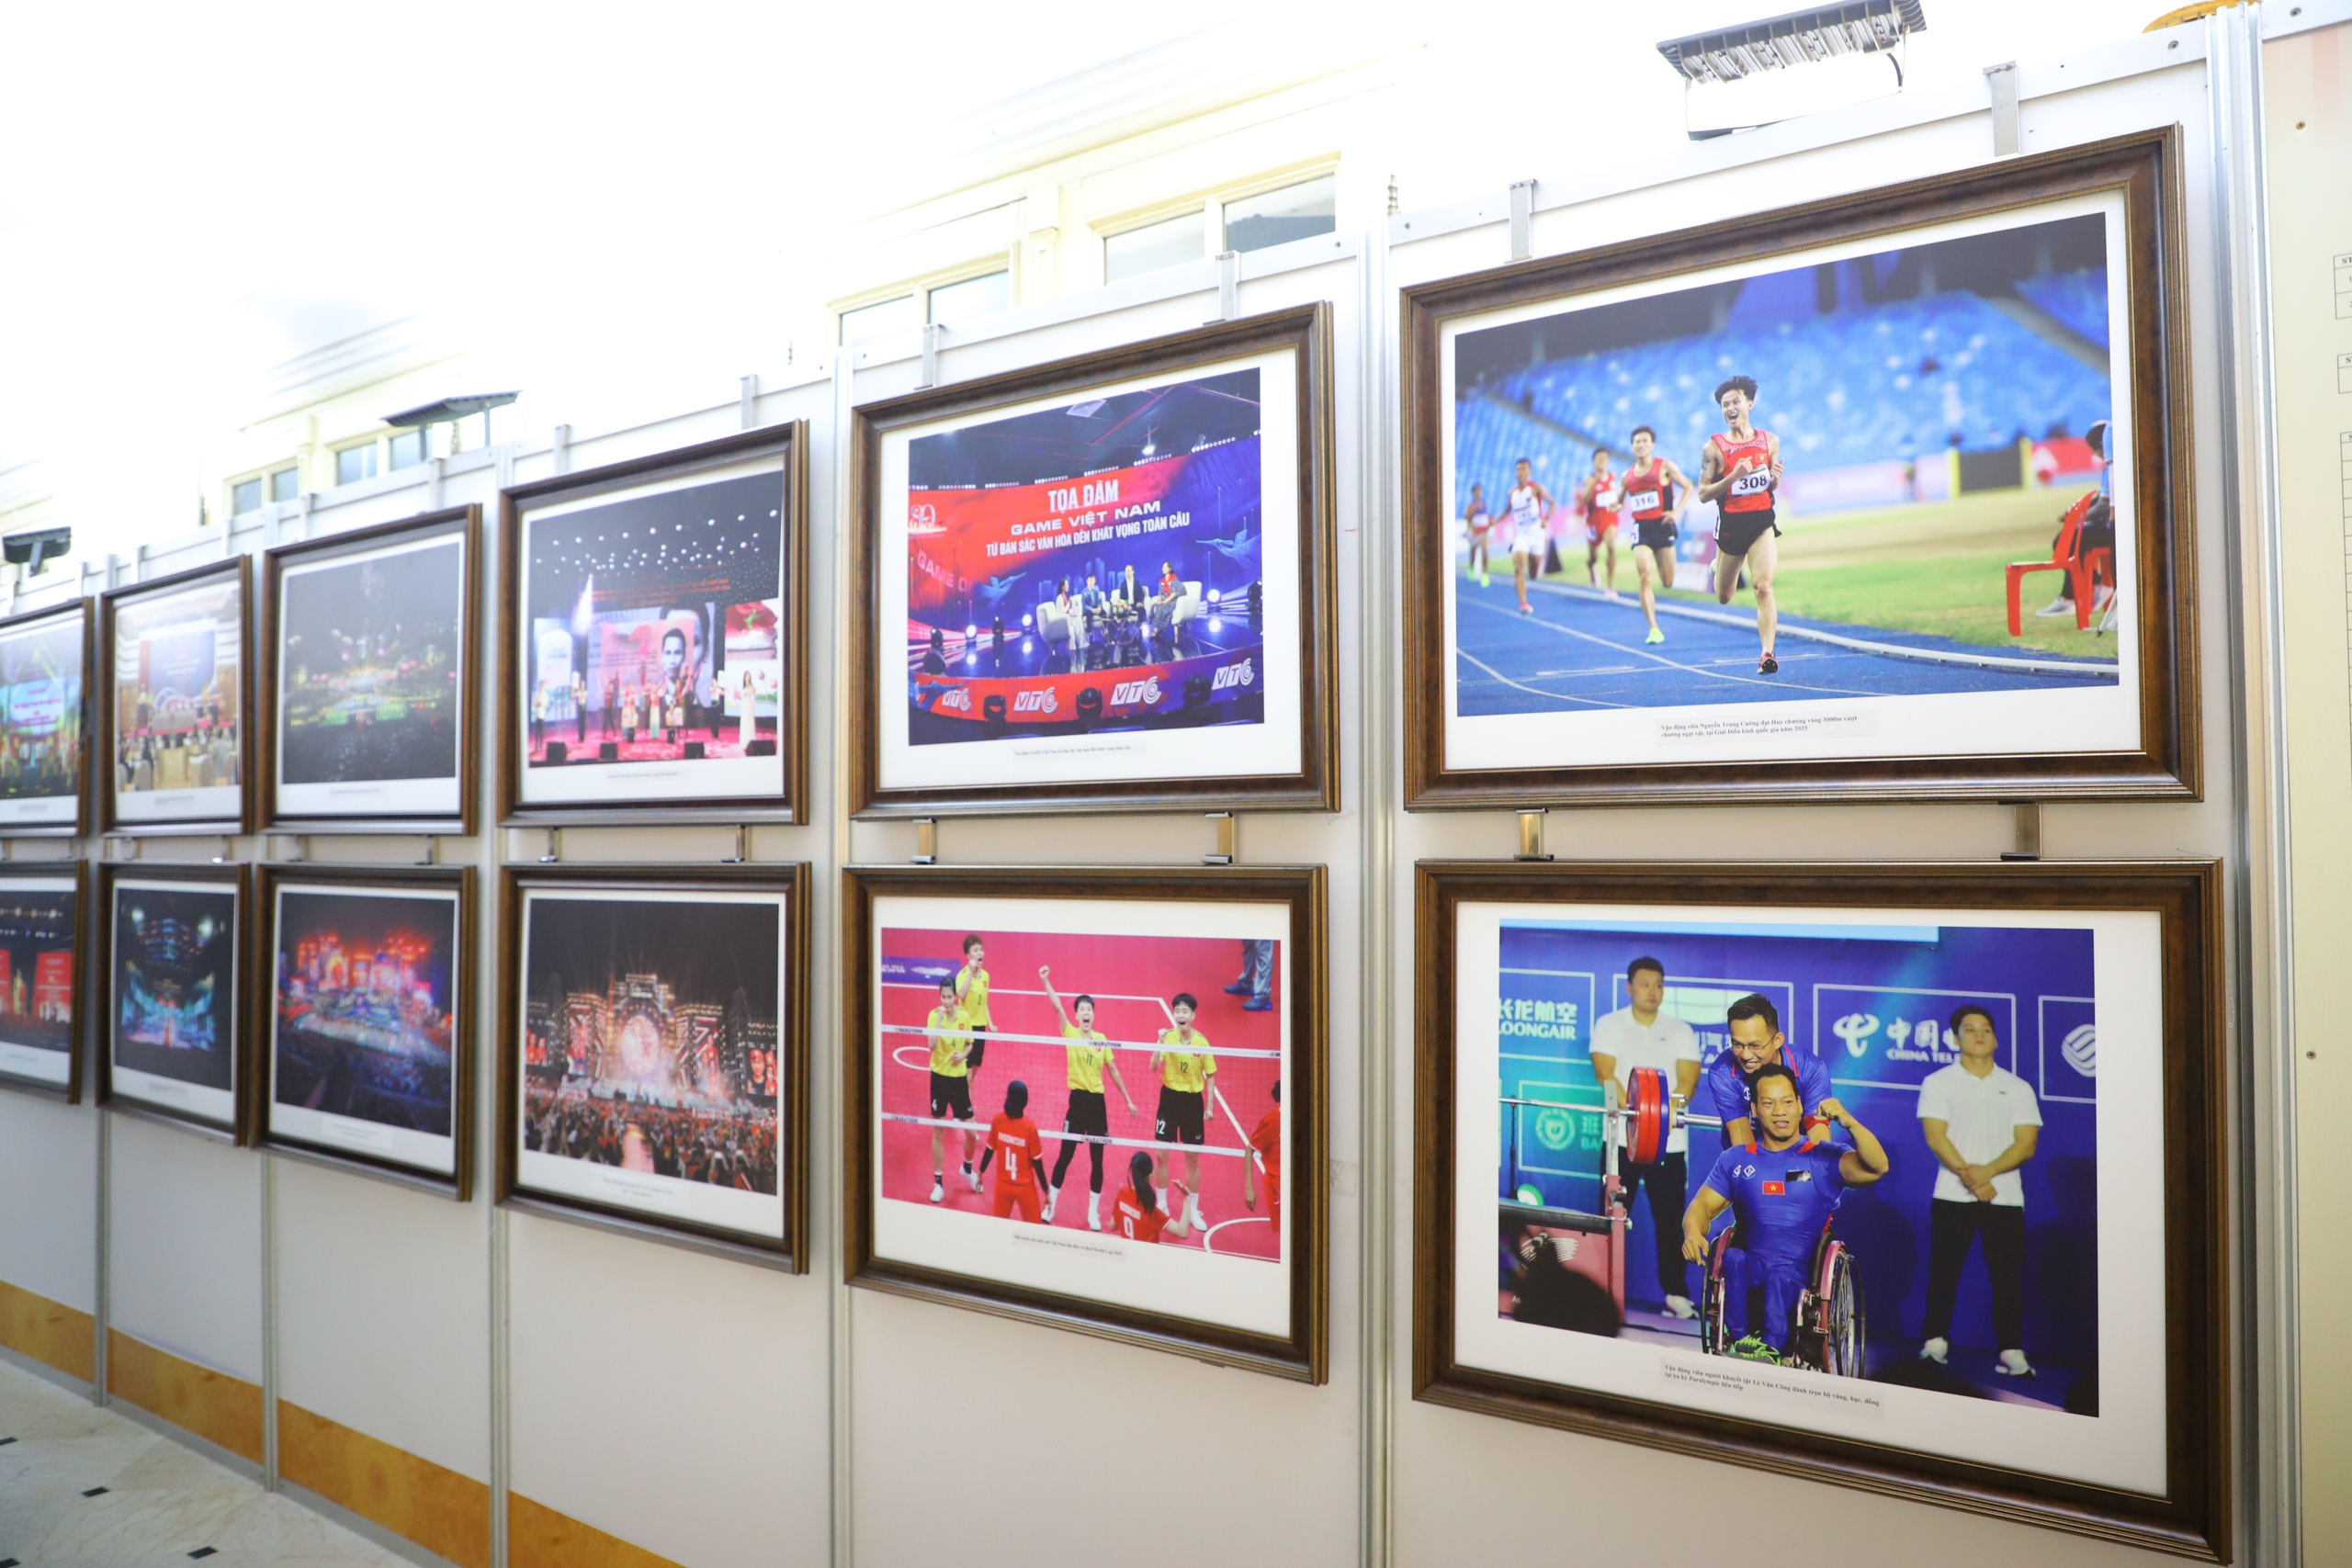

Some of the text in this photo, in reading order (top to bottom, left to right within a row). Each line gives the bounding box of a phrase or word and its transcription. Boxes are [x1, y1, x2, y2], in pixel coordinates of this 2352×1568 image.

[1739, 475, 1767, 491] 308
[1047, 479, 1119, 513] TỌA ĐÀM
[1011, 501, 1160, 536] GAME VIỆT NAM
[1115, 522, 1140, 538] VỌNG
[917, 549, 954, 588] GAME
[978, 994, 982, 1005] 2
[1086, 1054, 1092, 1067] 11
[1886, 1048, 1929, 1062] CHINA
[1180, 1061, 1189, 1074] 12
[1156, 1119, 1166, 1135] 12
[1005, 1146, 1018, 1180] 4
[1123, 1216, 1134, 1240] 9
[1689, 1376, 1720, 1387] Paralympic
